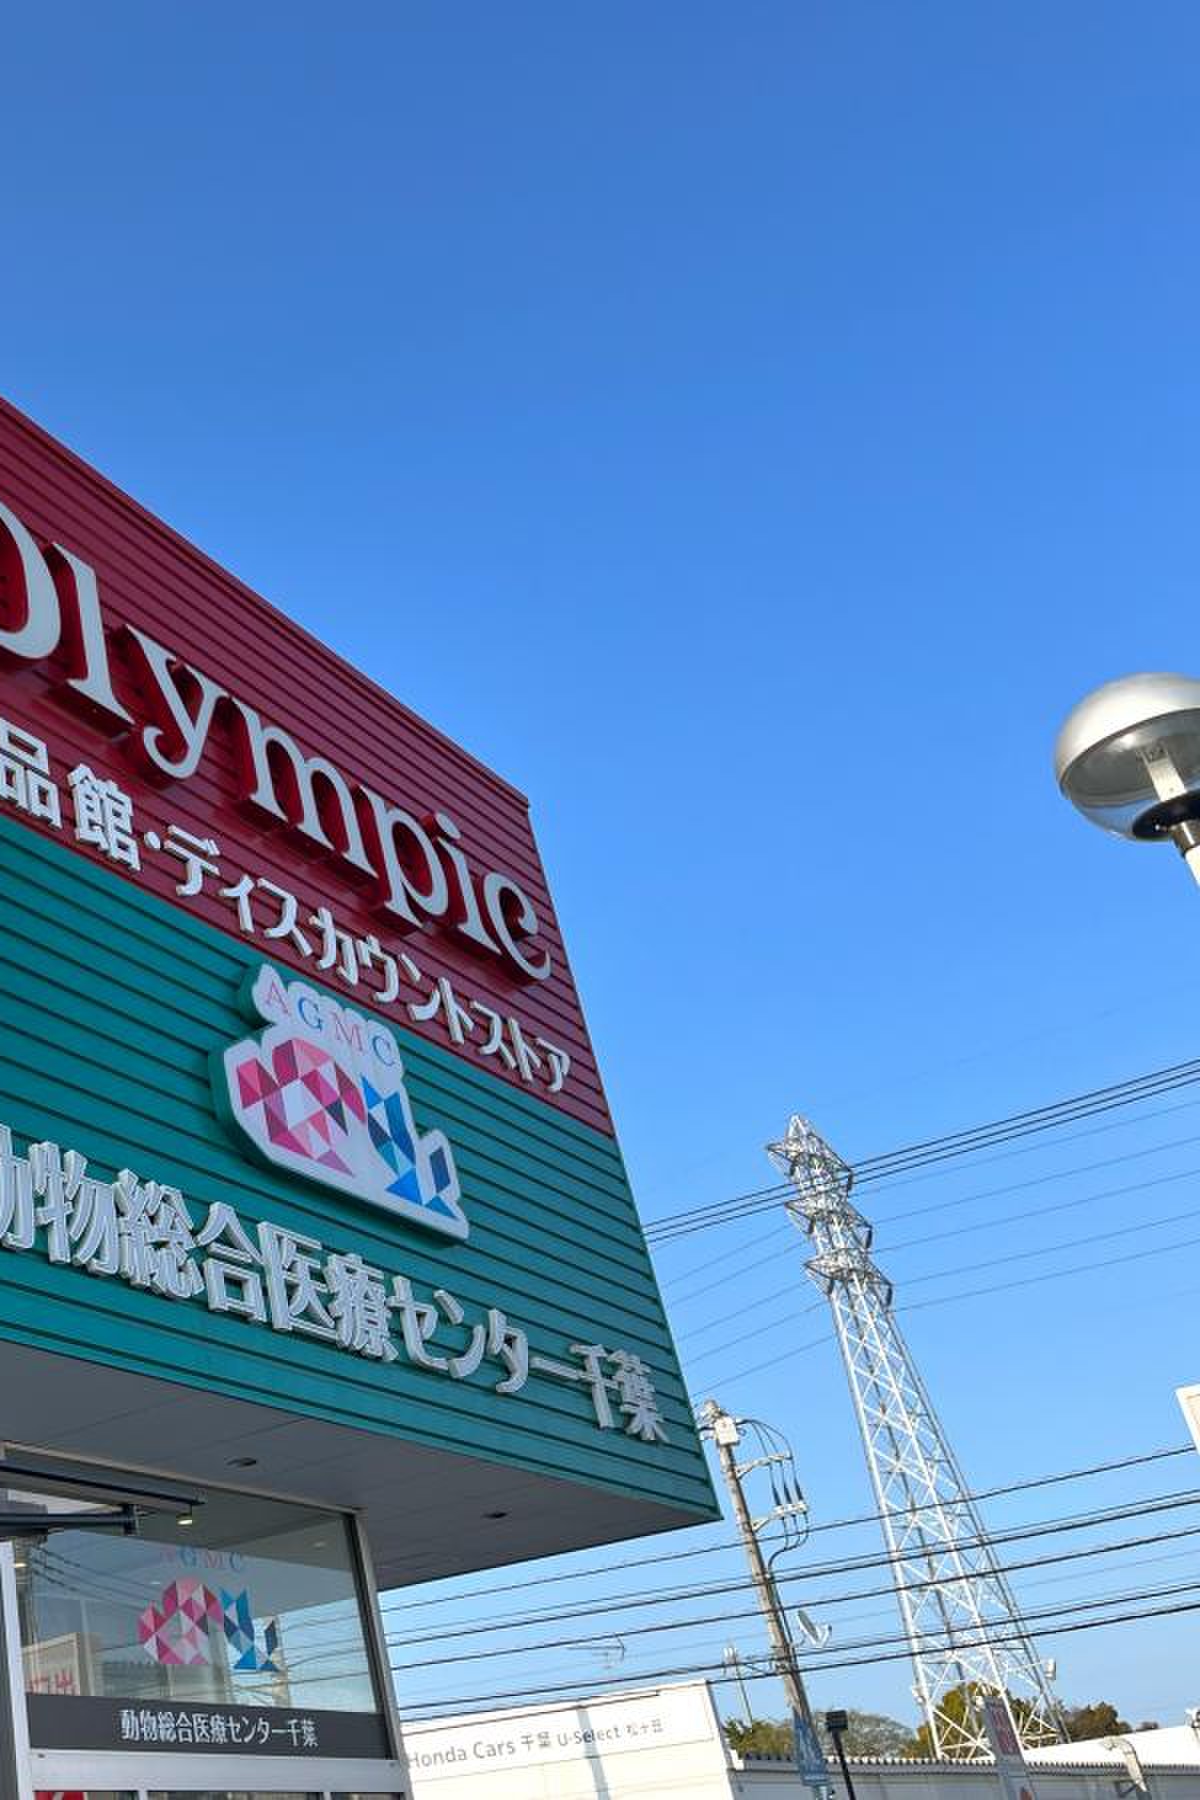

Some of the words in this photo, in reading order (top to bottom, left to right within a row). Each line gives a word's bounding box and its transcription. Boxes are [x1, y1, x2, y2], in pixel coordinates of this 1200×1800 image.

[264, 980, 397, 1067] AGMC
[120, 1708, 320, 1748] 動物総合医療センター千葉
[408, 1745, 467, 1768] Honda
[472, 1740, 516, 1760] Cars
